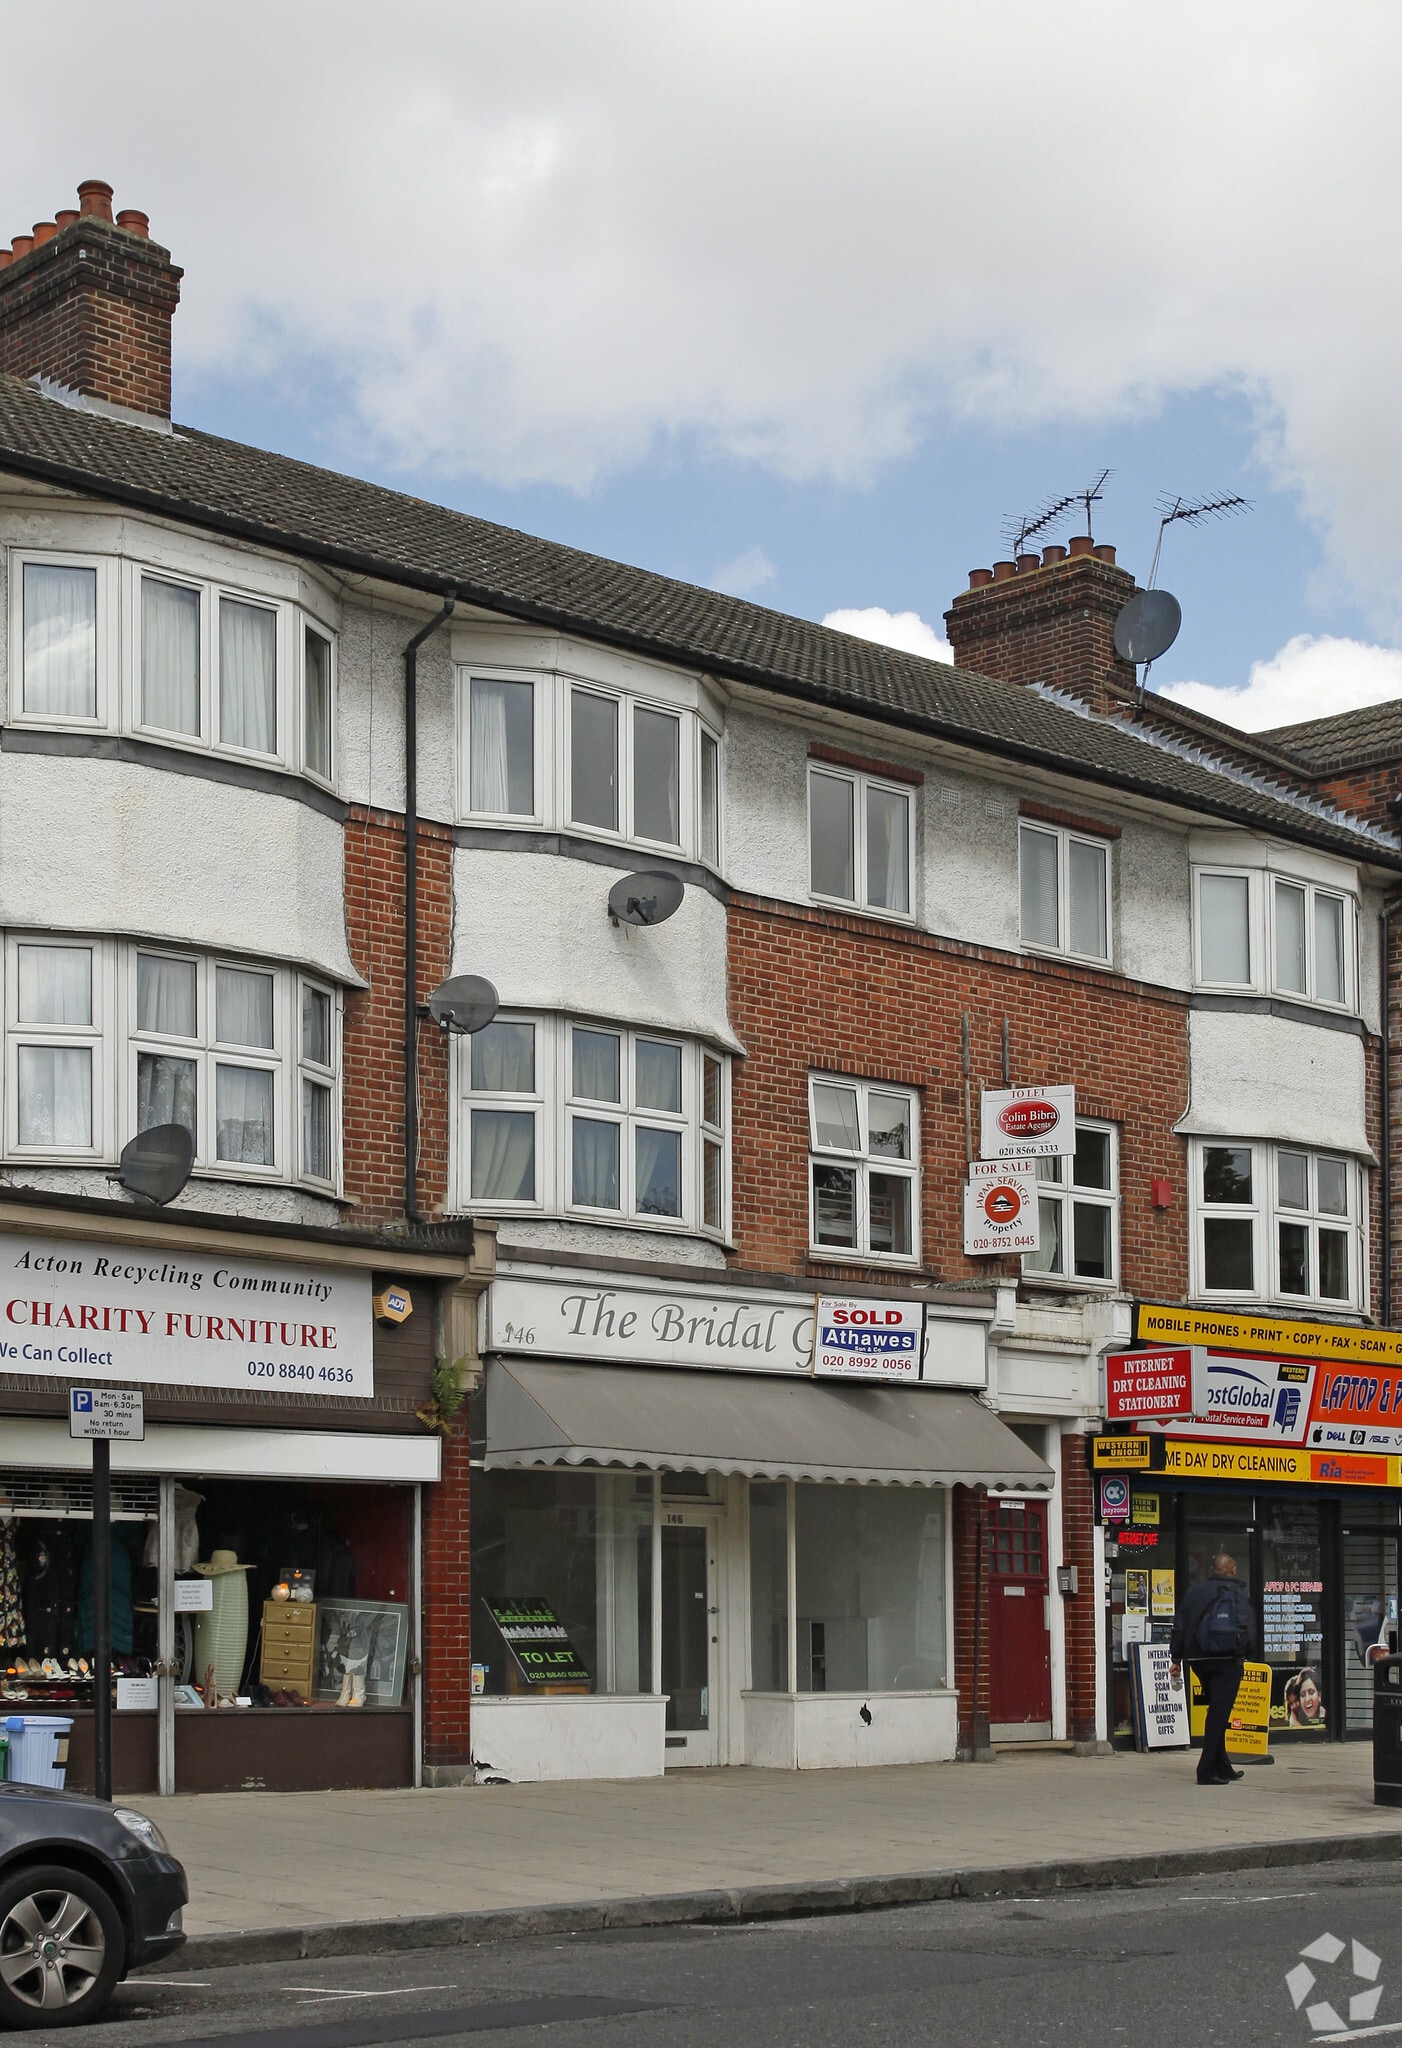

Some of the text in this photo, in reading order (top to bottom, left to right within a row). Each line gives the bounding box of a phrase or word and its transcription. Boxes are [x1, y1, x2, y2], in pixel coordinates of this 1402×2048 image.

[1010, 1088, 1047, 1098] TO LET
[1001, 1110, 1056, 1123] Colin Bibra
[1005, 1121, 1051, 1131] Estate Agents
[999, 1145, 1058, 1156] 020 8566 3333
[974, 1161, 1032, 1175] FOR SALE
[976, 1176, 1030, 1209] JAPAN SERVICES
[983, 1217, 1023, 1234] Property
[1015, 1235, 1035, 1246] 0445
[14, 1250, 332, 1302] Acton Recycling Community
[388, 1297, 407, 1312] ADT
[561, 1292, 638, 1339] The
[652, 1303, 785, 1353] Bridal
[833, 1309, 903, 1325] SOLD
[6, 1299, 338, 1350] CHARITY FURNITURE
[502, 1324, 536, 1345] 146
[825, 1328, 912, 1348] Athawes
[1147, 1317, 1191, 1332] MOBILE
[1194, 1322, 1239, 1337] PHONES
[1250, 1328, 1283, 1341] PRINT
[1293, 1332, 1321, 1345] COPY
[1331, 1336, 1350, 1348] FAX
[1360, 1339, 1386, 1352] SCAN
[22, 1344, 53, 1361] Can
[57, 1347, 113, 1365] Collect
[822, 1355, 912, 1370] 020 8992 0056
[1124, 1357, 1174, 1374] INTERNET
[248, 1361, 354, 1382] 020 8840 4636
[1281, 1366, 1306, 1374] WESTERN
[1288, 1373, 1306, 1381] UNION
[1113, 1375, 1186, 1393] DRY CLEANING
[1208, 1385, 1275, 1408] ostGlobal
[1321, 1373, 1378, 1413] LAPTOP
[1378, 1378, 1391, 1413] &
[77, 1393, 88, 1410] P
[1119, 1394, 1181, 1411] STATIONERY
[1222, 1415, 1245, 1424] Service
[1246, 1416, 1263, 1426] Point
[1326, 1430, 1346, 1441] DELL
[1369, 1435, 1391, 1443] ASUS
[1098, 1441, 1139, 1450] WESTERN
[1165, 1451, 1296, 1473] ME DAY DRY CLEANING
[1319, 1458, 1342, 1478] Ria
[1103, 1507, 1127, 1515] payzone
[667, 1514, 683, 1524] 146
[1264, 1581, 1284, 1592] APTOP
[1290, 1582, 1299, 1592] PC
[520, 1652, 575, 1663] TO LET
[1148, 1650, 1171, 1659] INTERNE
[1153, 1660, 1169, 1670] PRINT
[1154, 1671, 1169, 1680] COPY
[1154, 1682, 1170, 1691] SCAN
[1158, 1693, 1169, 1702] FAX
[1148, 1703, 1183, 1713] LAMINATION
[1156, 1714, 1176, 1724] CARDS
[1158, 1725, 1175, 1735] GIFTS
